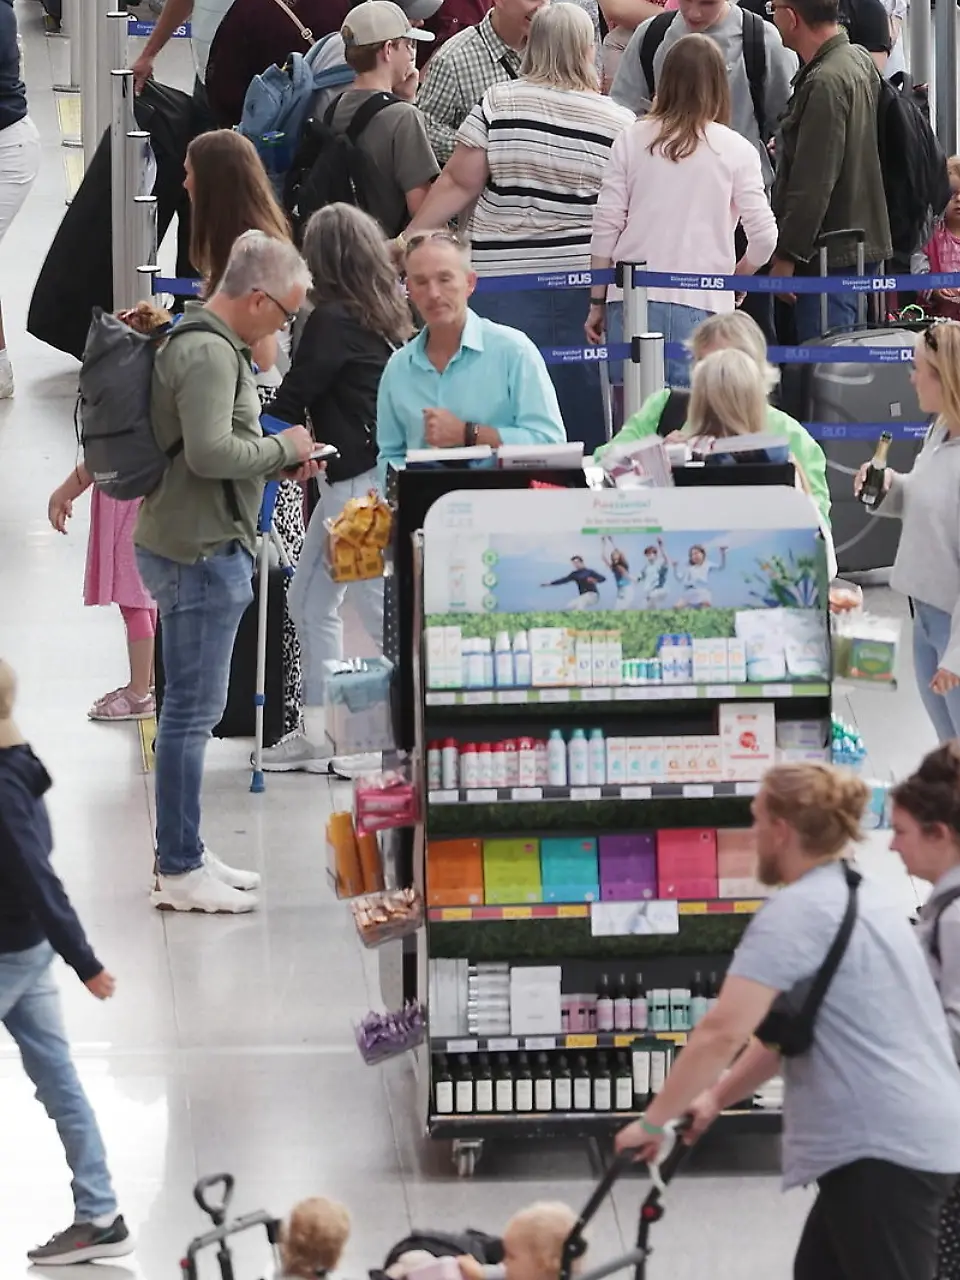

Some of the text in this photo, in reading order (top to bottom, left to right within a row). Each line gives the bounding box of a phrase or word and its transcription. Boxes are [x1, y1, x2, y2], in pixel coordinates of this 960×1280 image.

[568, 273, 591, 285] DUS
[701, 278, 724, 288] DUS
[873, 279, 896, 289] DUS
[584, 348, 608, 359] DUS
[901, 349, 914, 360] DU
